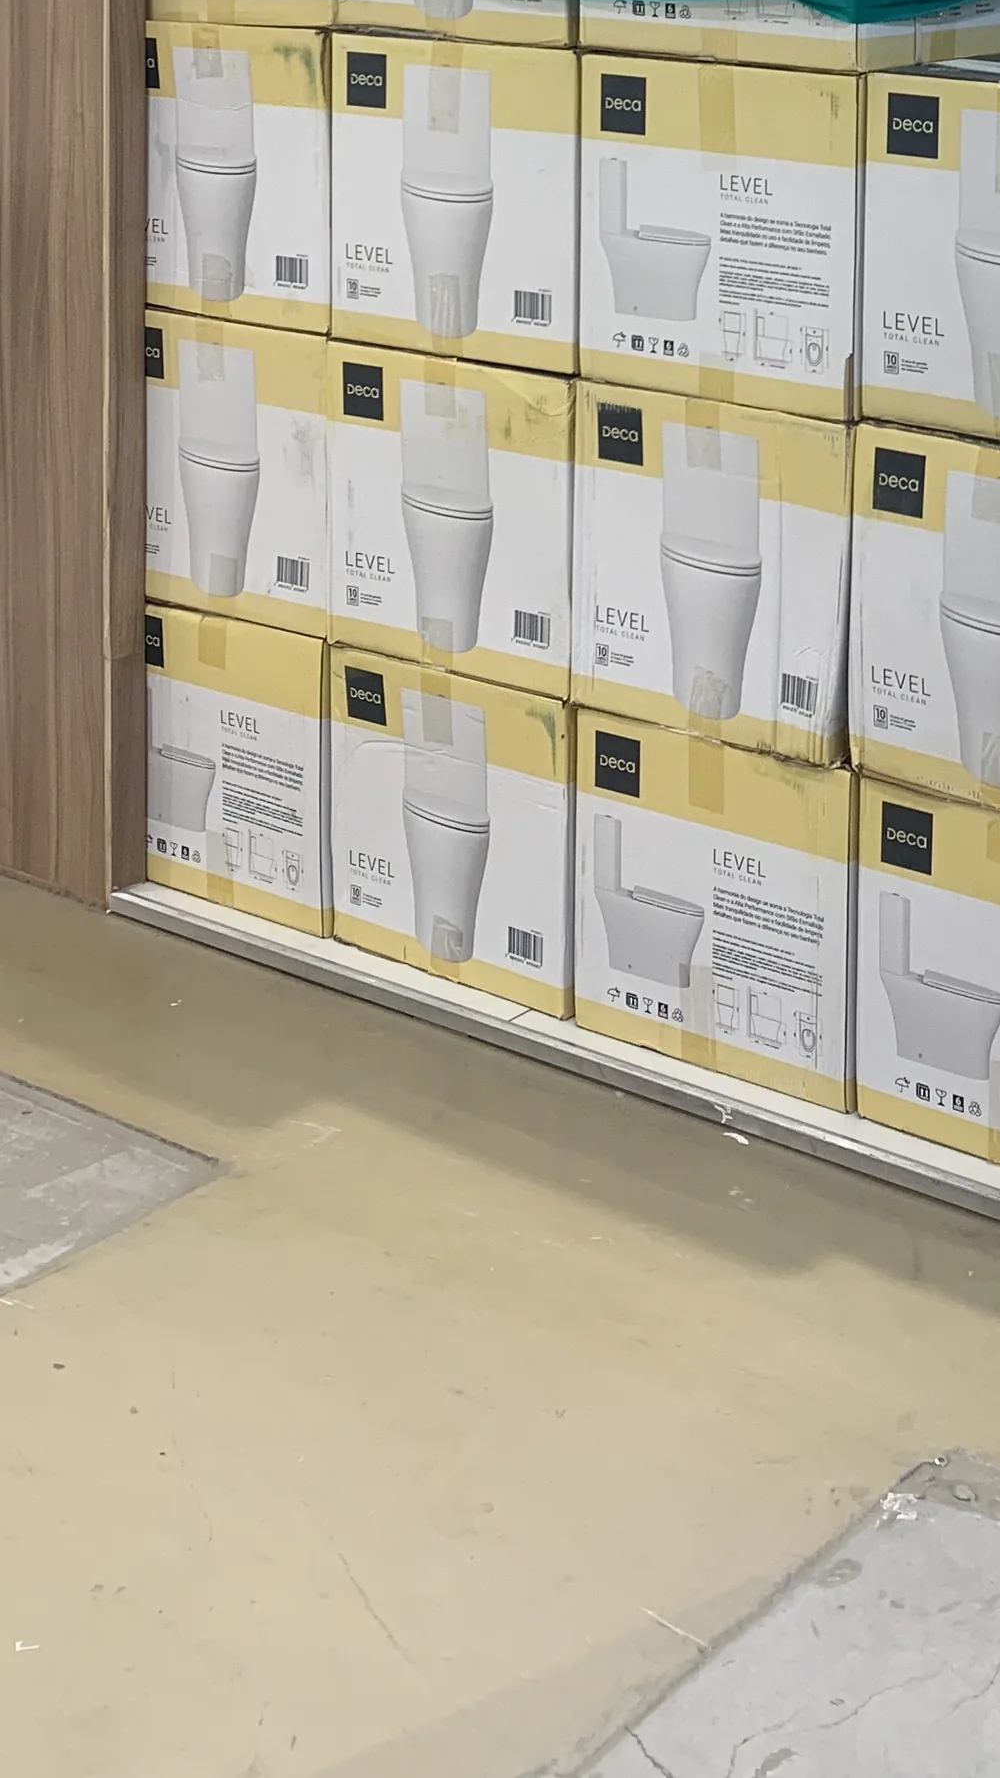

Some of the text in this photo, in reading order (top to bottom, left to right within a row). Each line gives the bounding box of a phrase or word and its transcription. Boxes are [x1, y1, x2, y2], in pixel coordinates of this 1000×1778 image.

[720, 174, 773, 196] LEVEL
[346, 243, 393, 265] LEVEL
[883, 311, 944, 337] LEVEL
[884, 332, 940, 346] TOTAL CLEAN
[886, 354, 897, 365] 10
[345, 550, 395, 575] LEVEL
[349, 587, 358, 598] 10
[596, 605, 649, 633] LEVEL
[598, 646, 607, 657] 10
[871, 665, 931, 697] LEVEL
[873, 686, 926, 706] TOTAL CLEAN
[220, 710, 260, 734] LEVEL
[875, 707, 886, 720] 10
[350, 850, 394, 878] LEVEL
[713, 848, 766, 878] LEVEL
[713, 867, 762, 886] TOTAL CLEAN
[352, 886, 360, 897] 10
